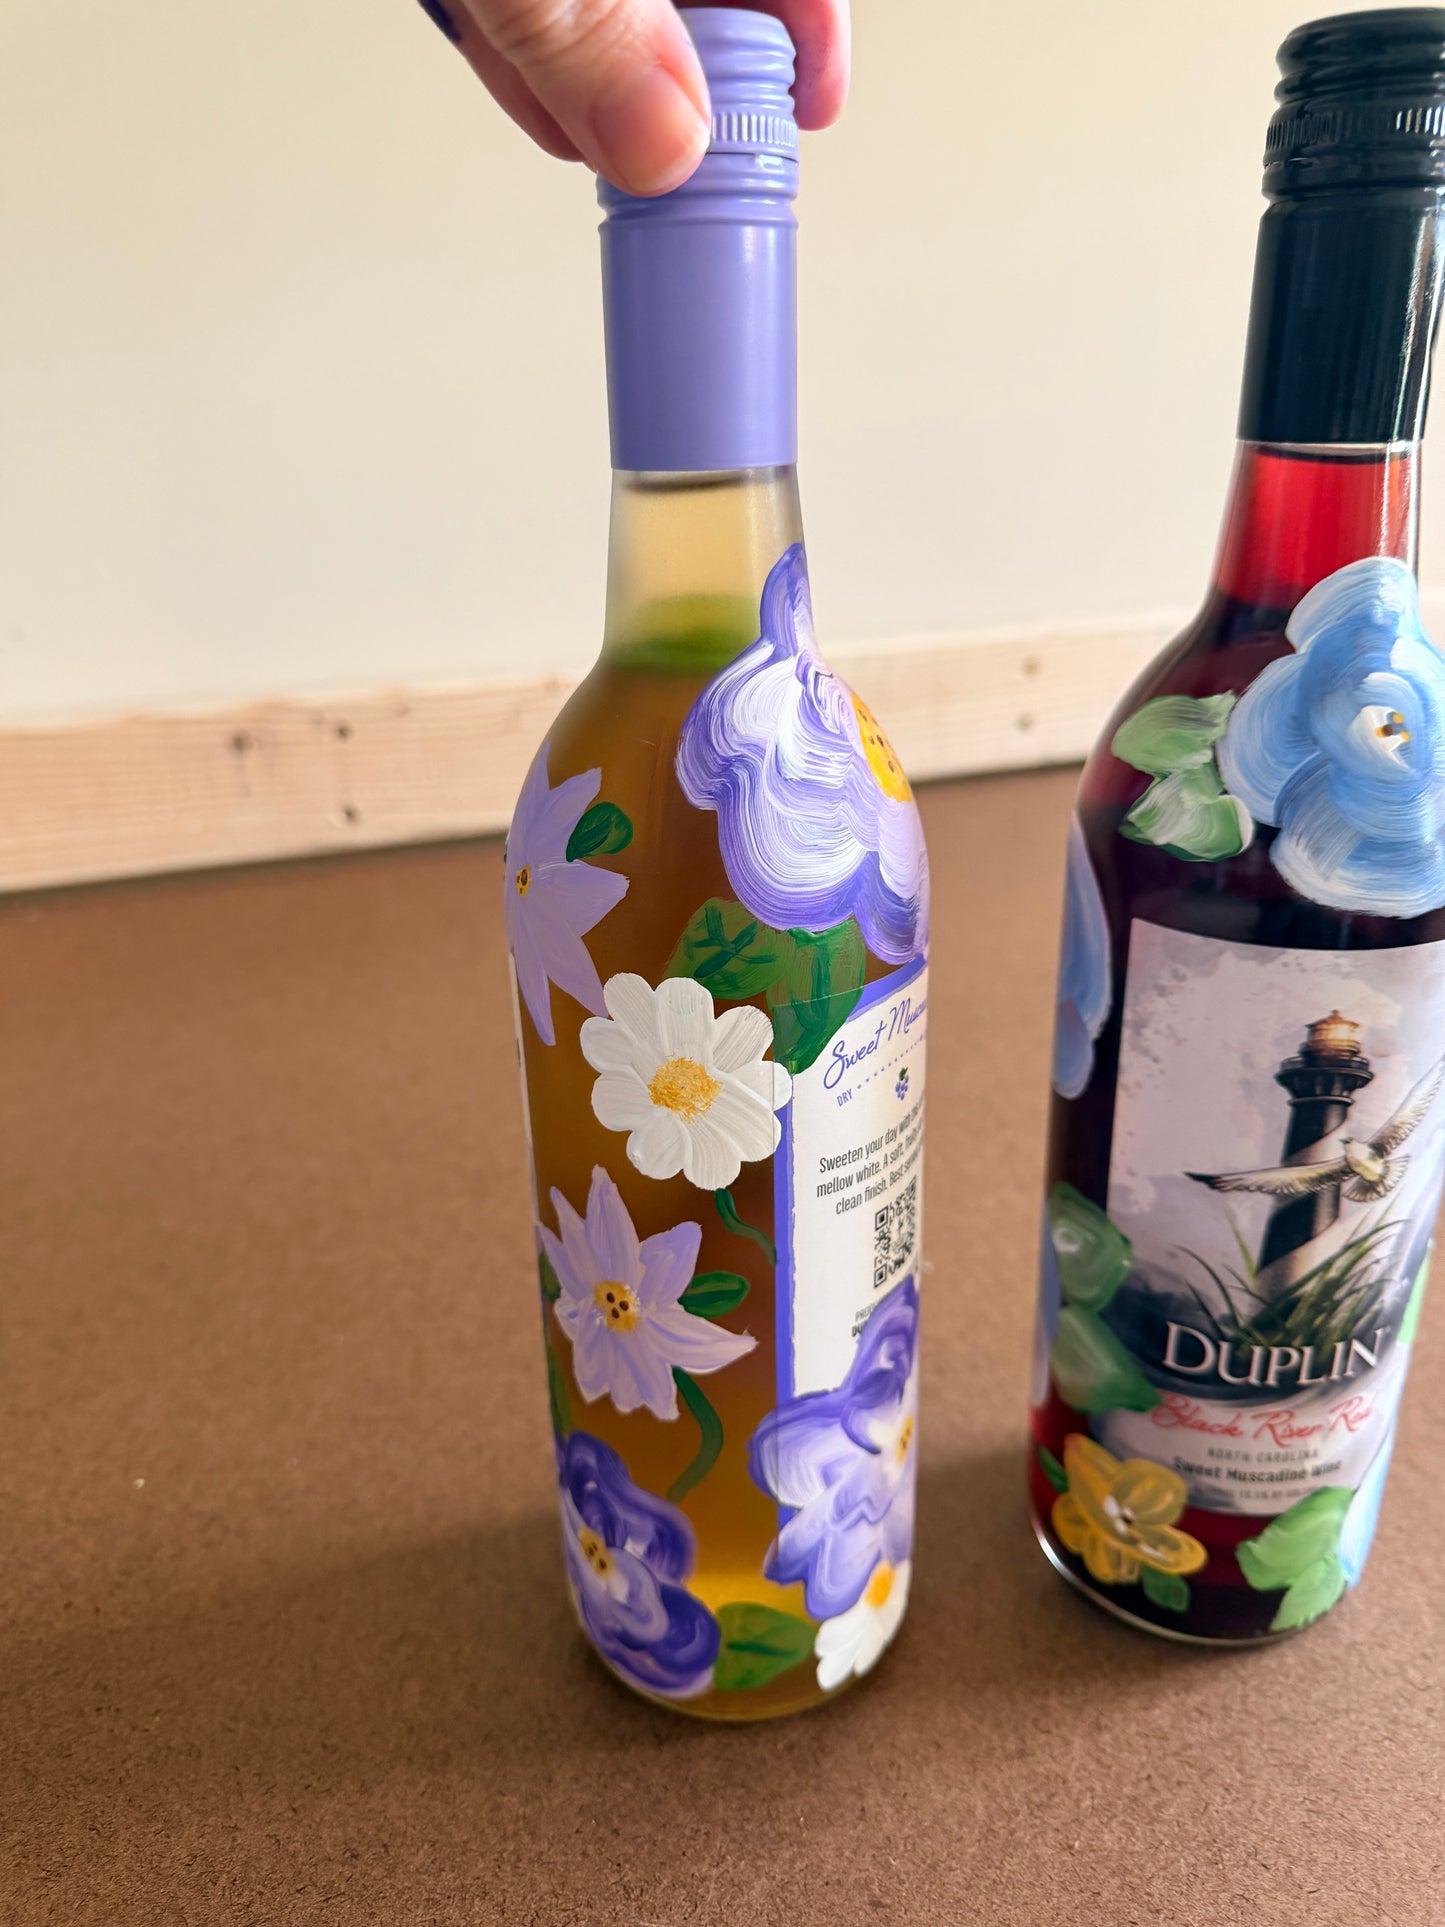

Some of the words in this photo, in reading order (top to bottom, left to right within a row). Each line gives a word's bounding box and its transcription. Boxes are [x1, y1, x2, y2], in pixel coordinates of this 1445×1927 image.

[824, 1020, 887, 1089] Sweet
[837, 1088, 852, 1106] DRY
[820, 1147, 863, 1173] Sweeten
[865, 1135, 883, 1160] your
[885, 1126, 898, 1145] day
[817, 1174, 853, 1198] mellow
[856, 1161, 881, 1184] white.
[883, 1152, 888, 1169] A
[836, 1193, 862, 1215] clean
[864, 1177, 887, 1202] finish.
[889, 1164, 903, 1187] Best
[1162, 1320, 1382, 1388] DUPLIN
[1151, 1394, 1245, 1438] Black
[1252, 1410, 1324, 1448] River
[1174, 1456, 1223, 1479] Sweet
[1226, 1467, 1308, 1483] Muscadine
[1311, 1460, 1343, 1477] Wine
[1207, 1447, 1250, 1463] NORTH
[1256, 1448, 1319, 1464] CAROLINA
